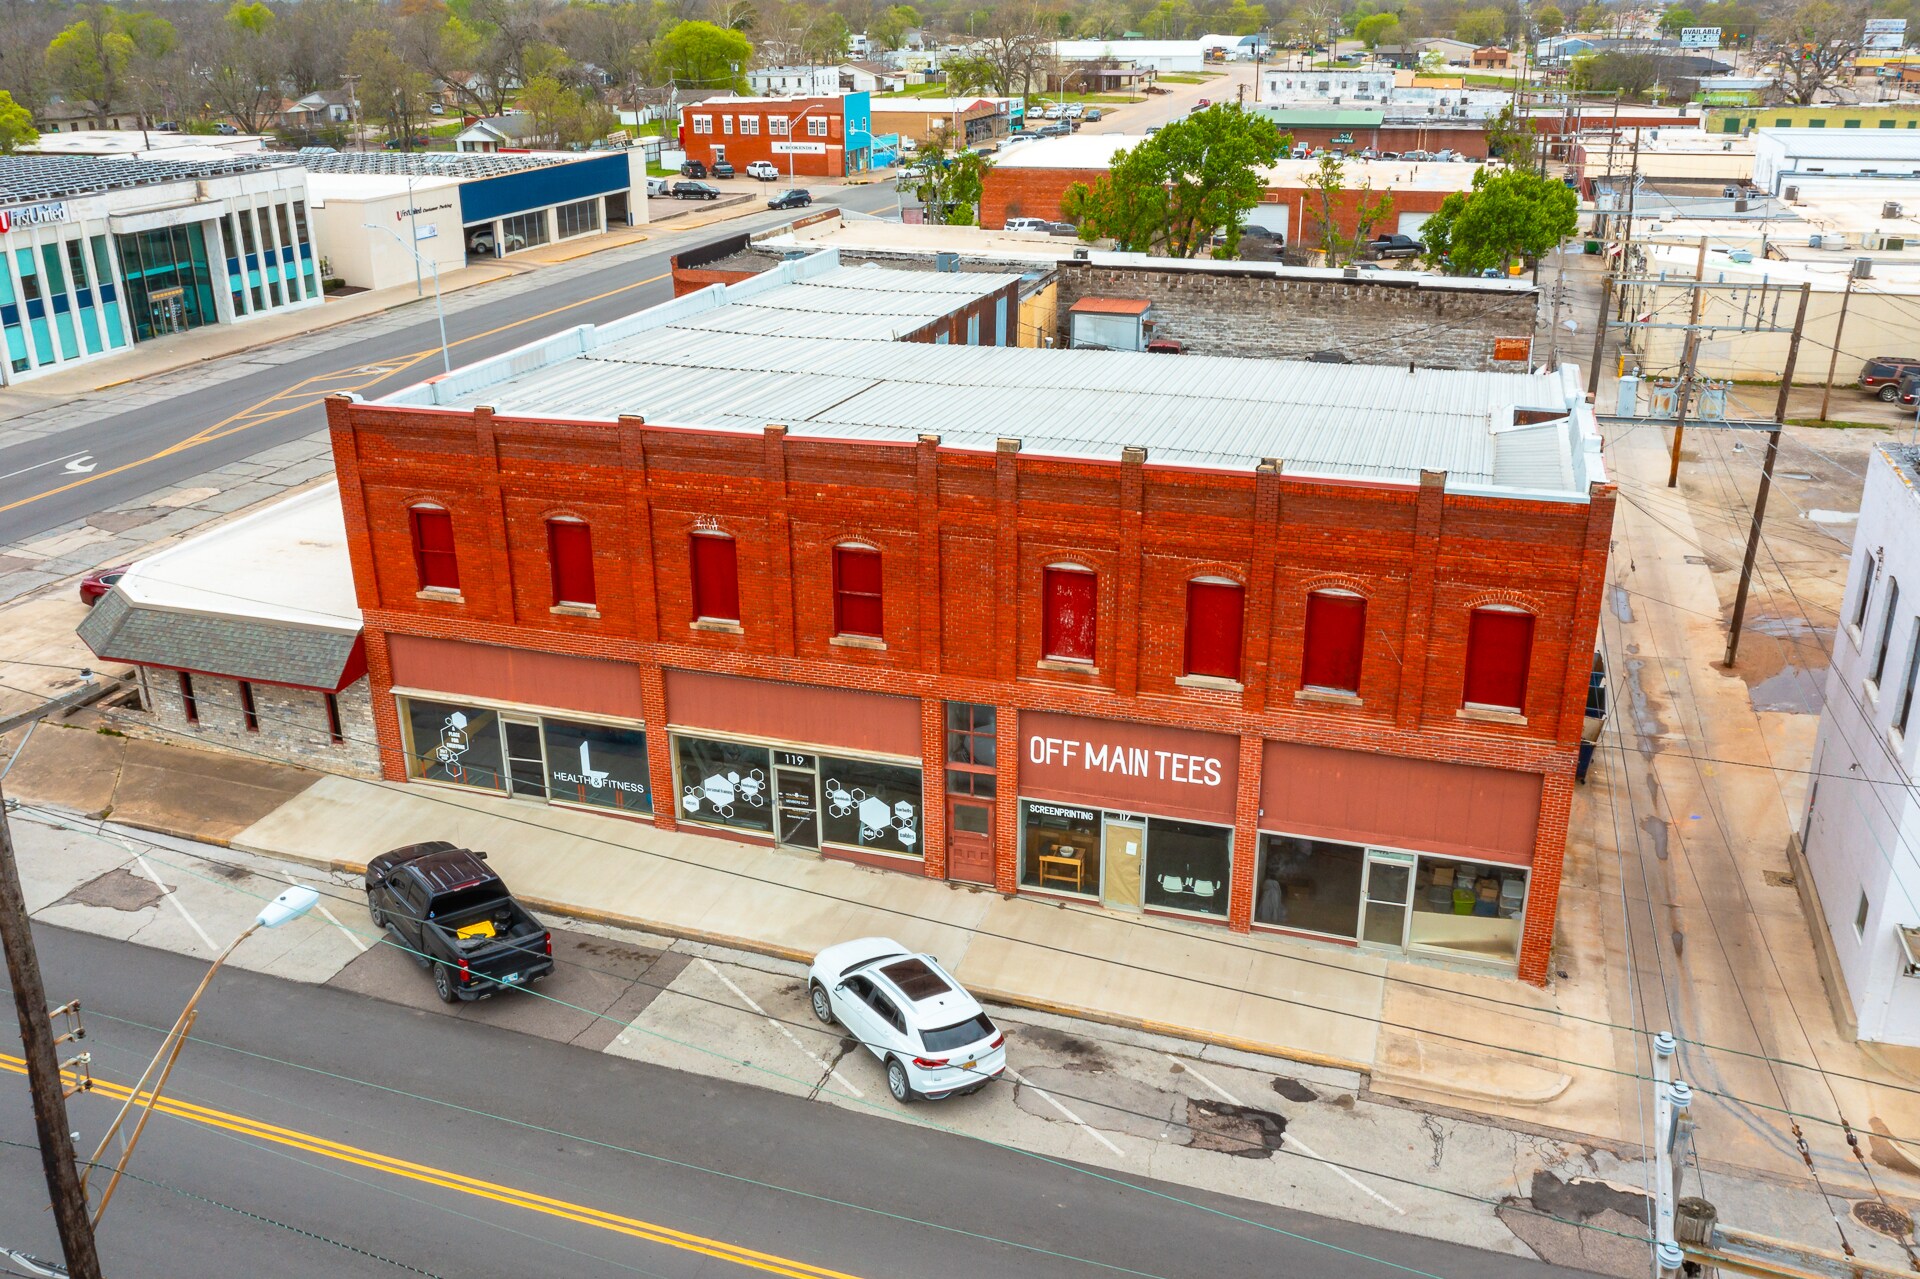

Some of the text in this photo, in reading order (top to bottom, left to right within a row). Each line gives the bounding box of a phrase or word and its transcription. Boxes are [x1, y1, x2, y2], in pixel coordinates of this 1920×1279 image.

[785, 754, 804, 765] 119
[1030, 736, 1222, 786] OFF MAIN TEES
[602, 779, 645, 793] FITNESS
[1030, 804, 1094, 820] SCREENPRINTING
[899, 832, 915, 840] cables
